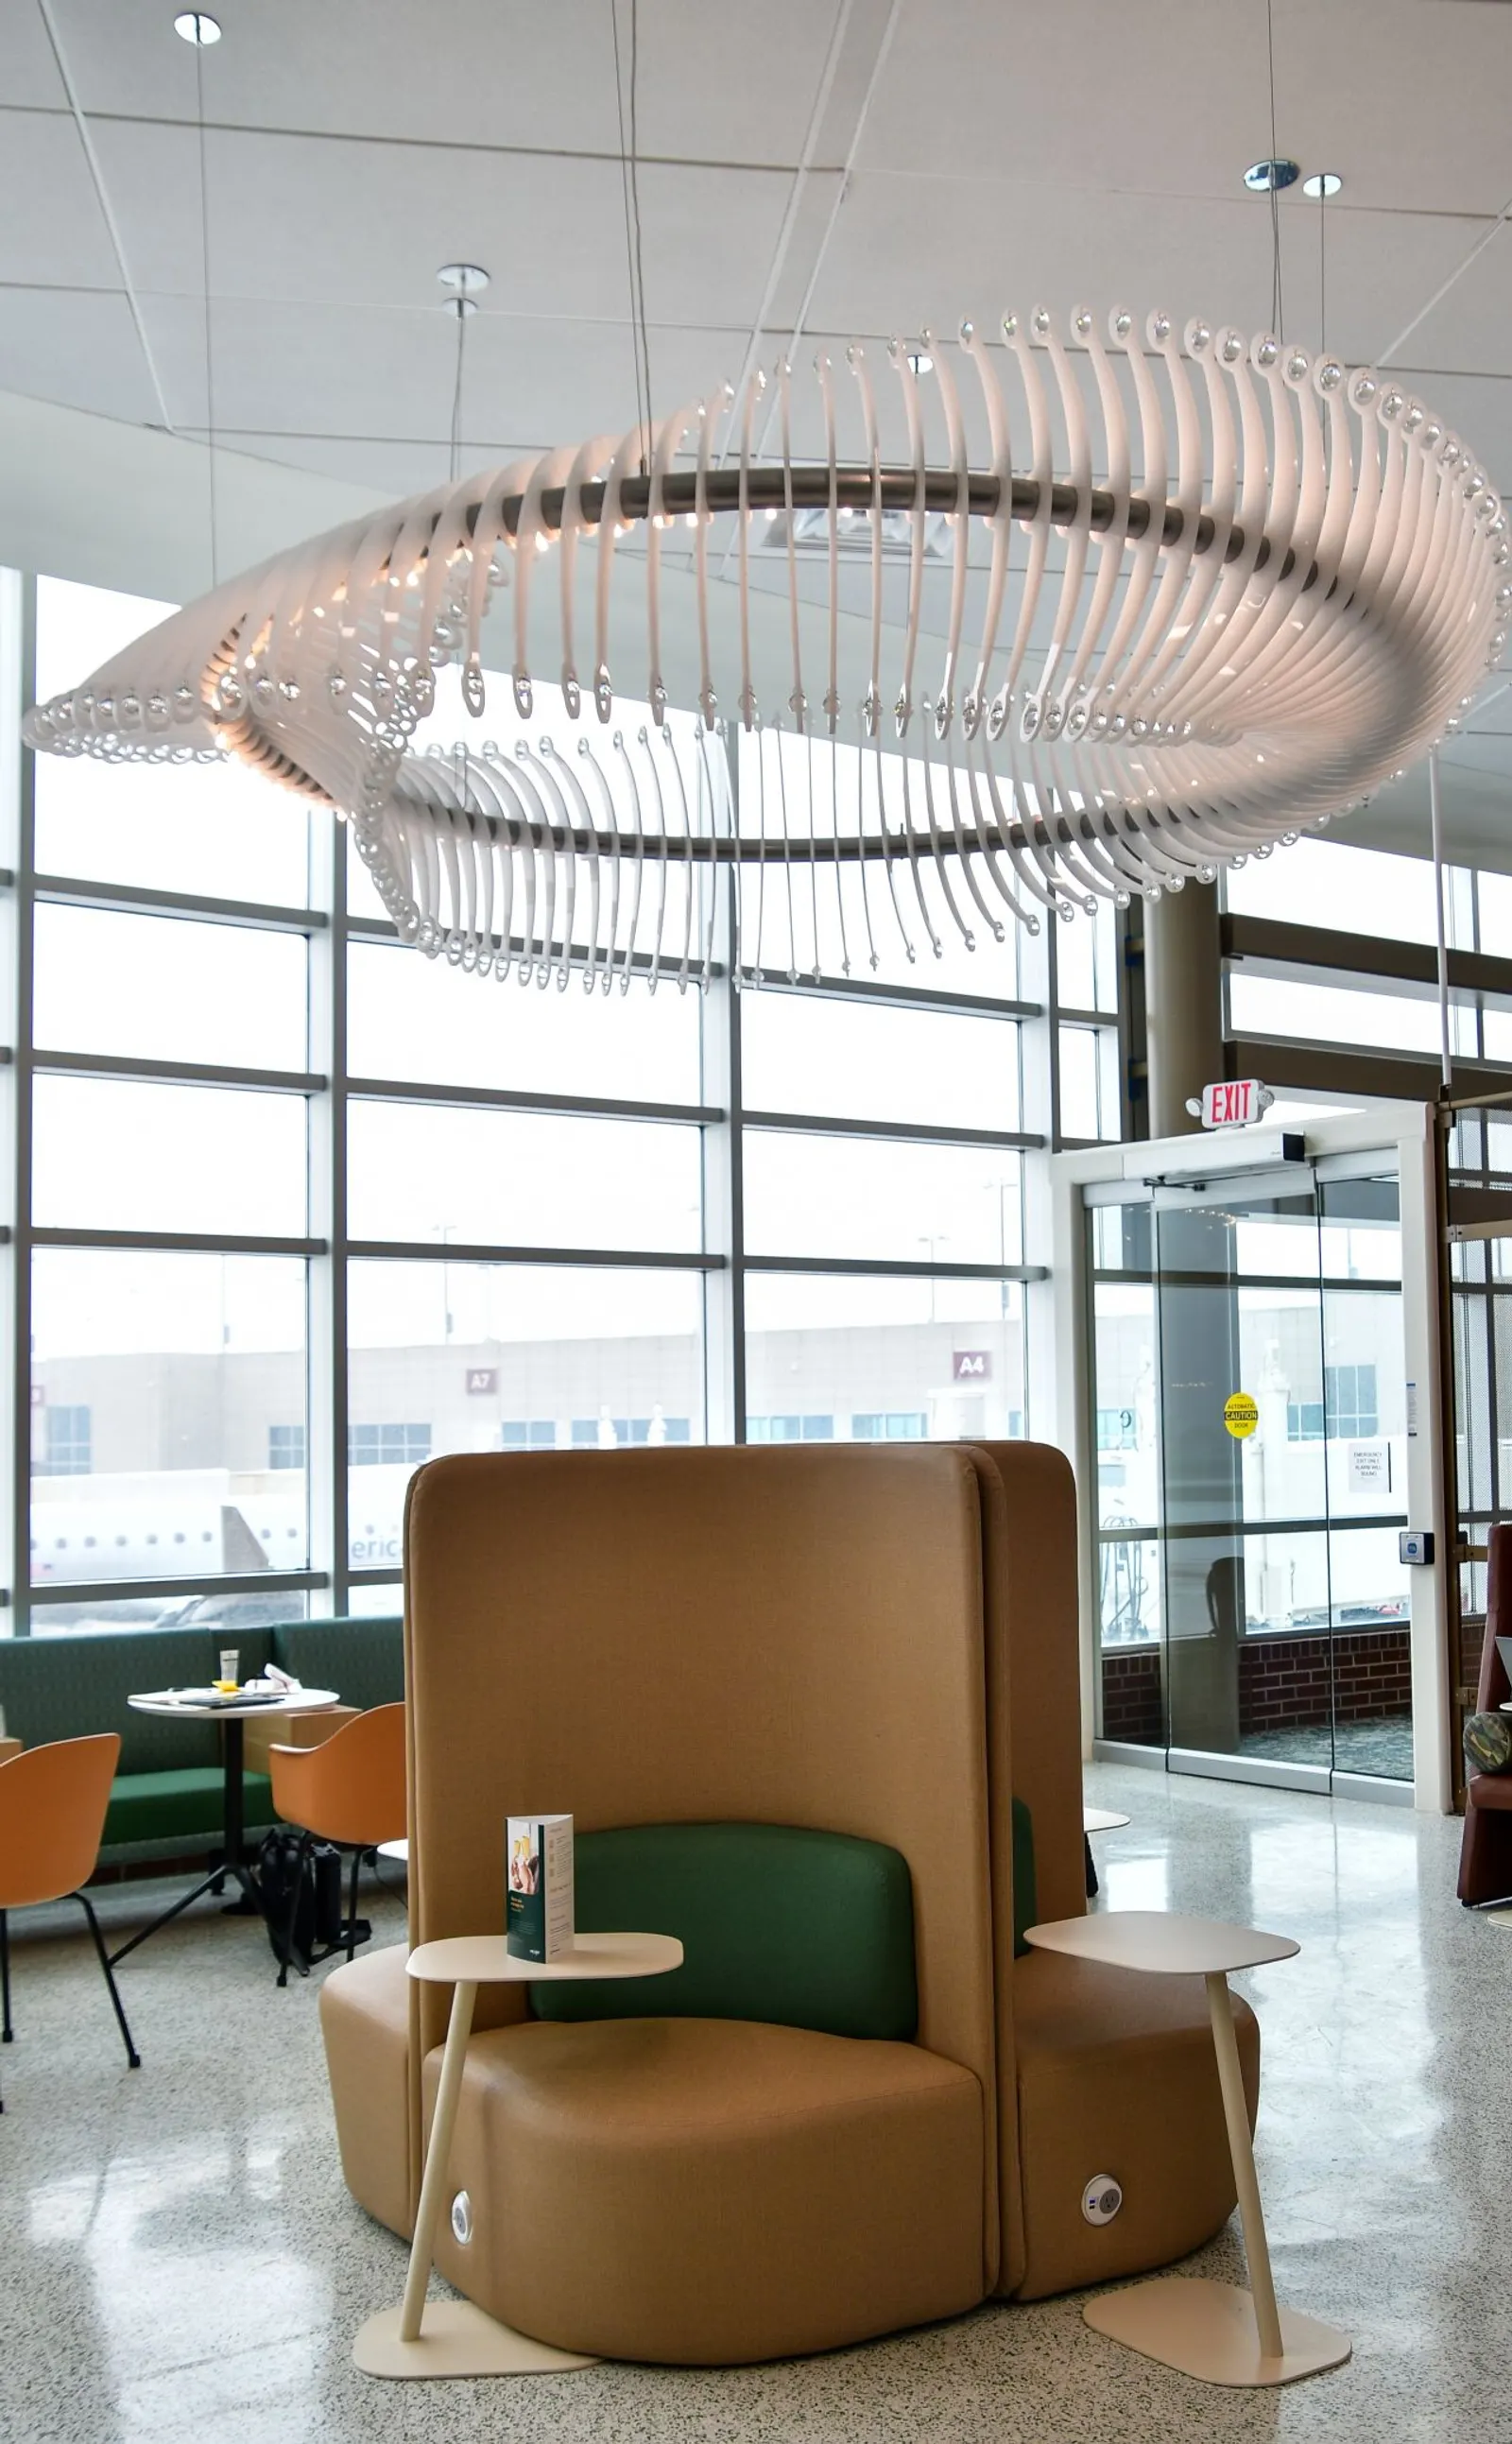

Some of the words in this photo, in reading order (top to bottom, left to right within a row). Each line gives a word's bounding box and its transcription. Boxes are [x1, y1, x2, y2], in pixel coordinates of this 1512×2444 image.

[1211, 1082, 1251, 1123] EXIT
[959, 1356, 985, 1374] A4
[471, 1373, 490, 1389] A7
[1225, 1411, 1257, 1420] CAUTION
[351, 1535, 404, 1559] eric
